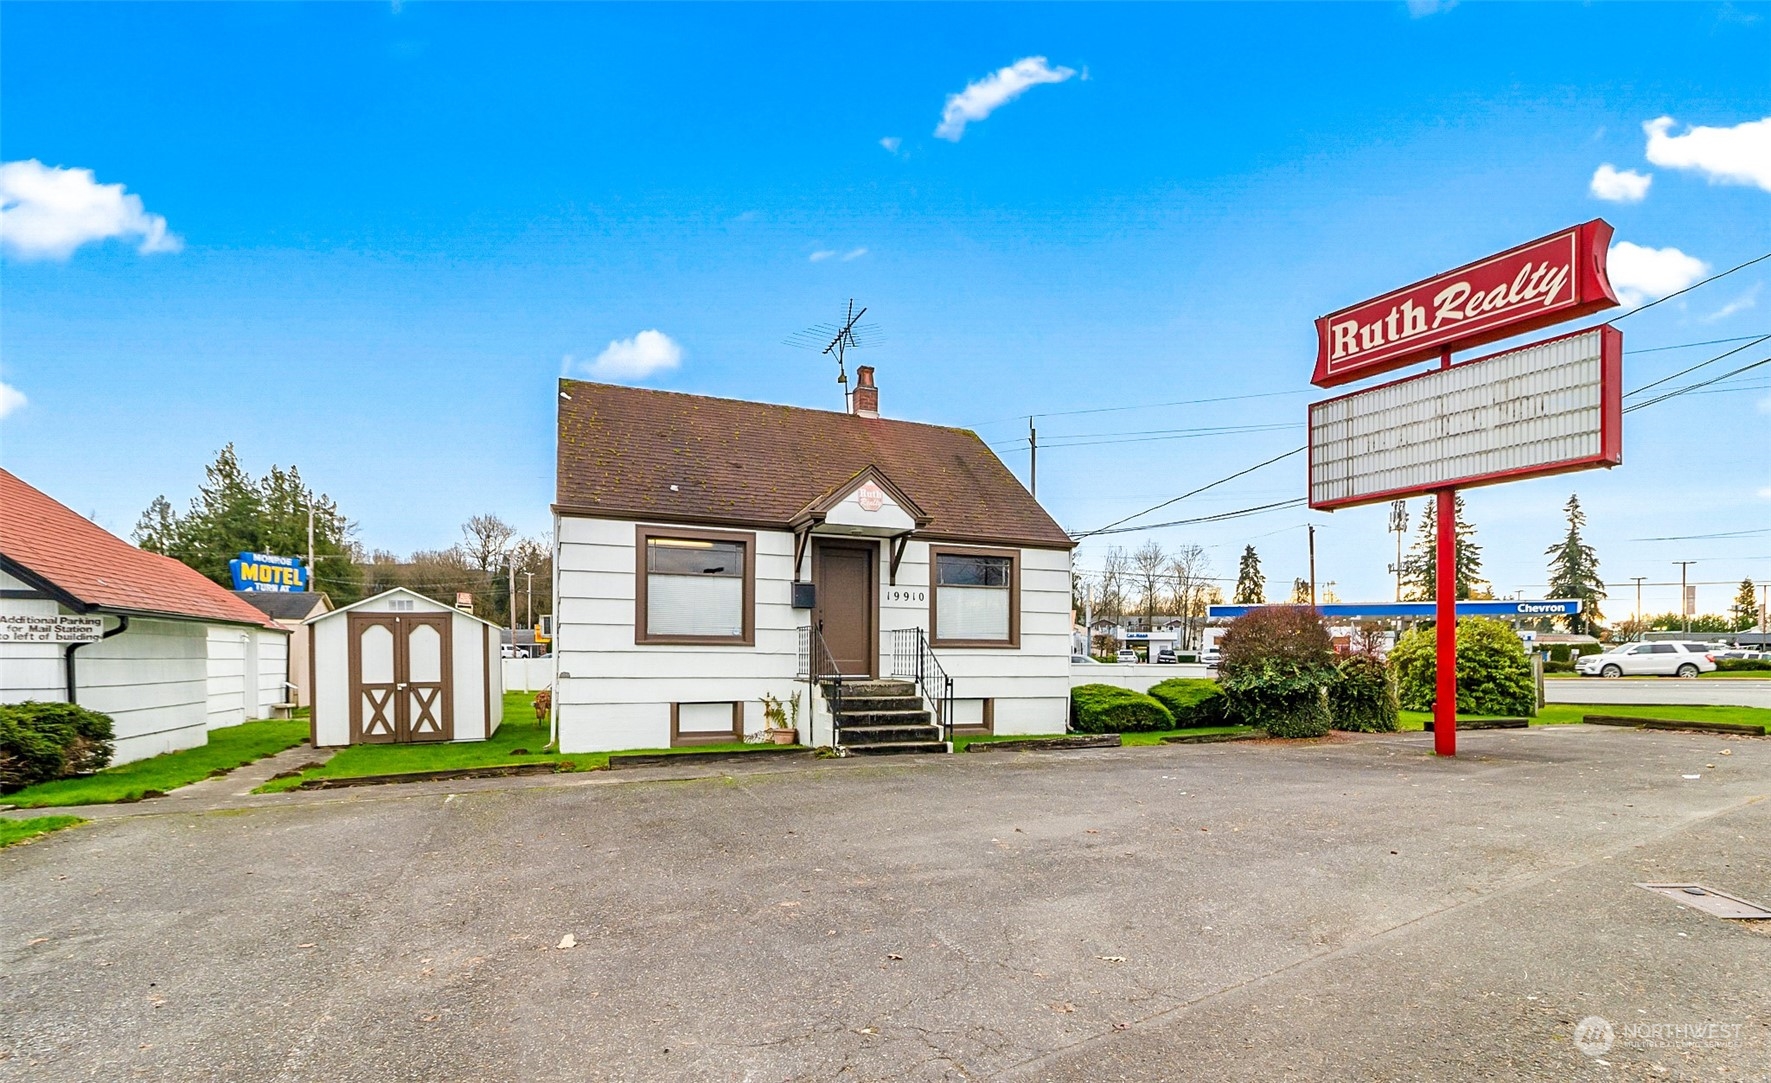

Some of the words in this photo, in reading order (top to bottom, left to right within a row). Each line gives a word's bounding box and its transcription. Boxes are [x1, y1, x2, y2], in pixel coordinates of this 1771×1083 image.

[1331, 298, 1428, 359] Ruth
[1432, 261, 1569, 328] Realty
[859, 489, 882, 499] Ruth
[252, 553, 292, 565] MONROE
[241, 562, 303, 586] MOTEL
[887, 591, 925, 601] 19910
[1517, 604, 1565, 612] Chevron
[0, 616, 57, 624] Additional
[60, 617, 101, 626] Parking
